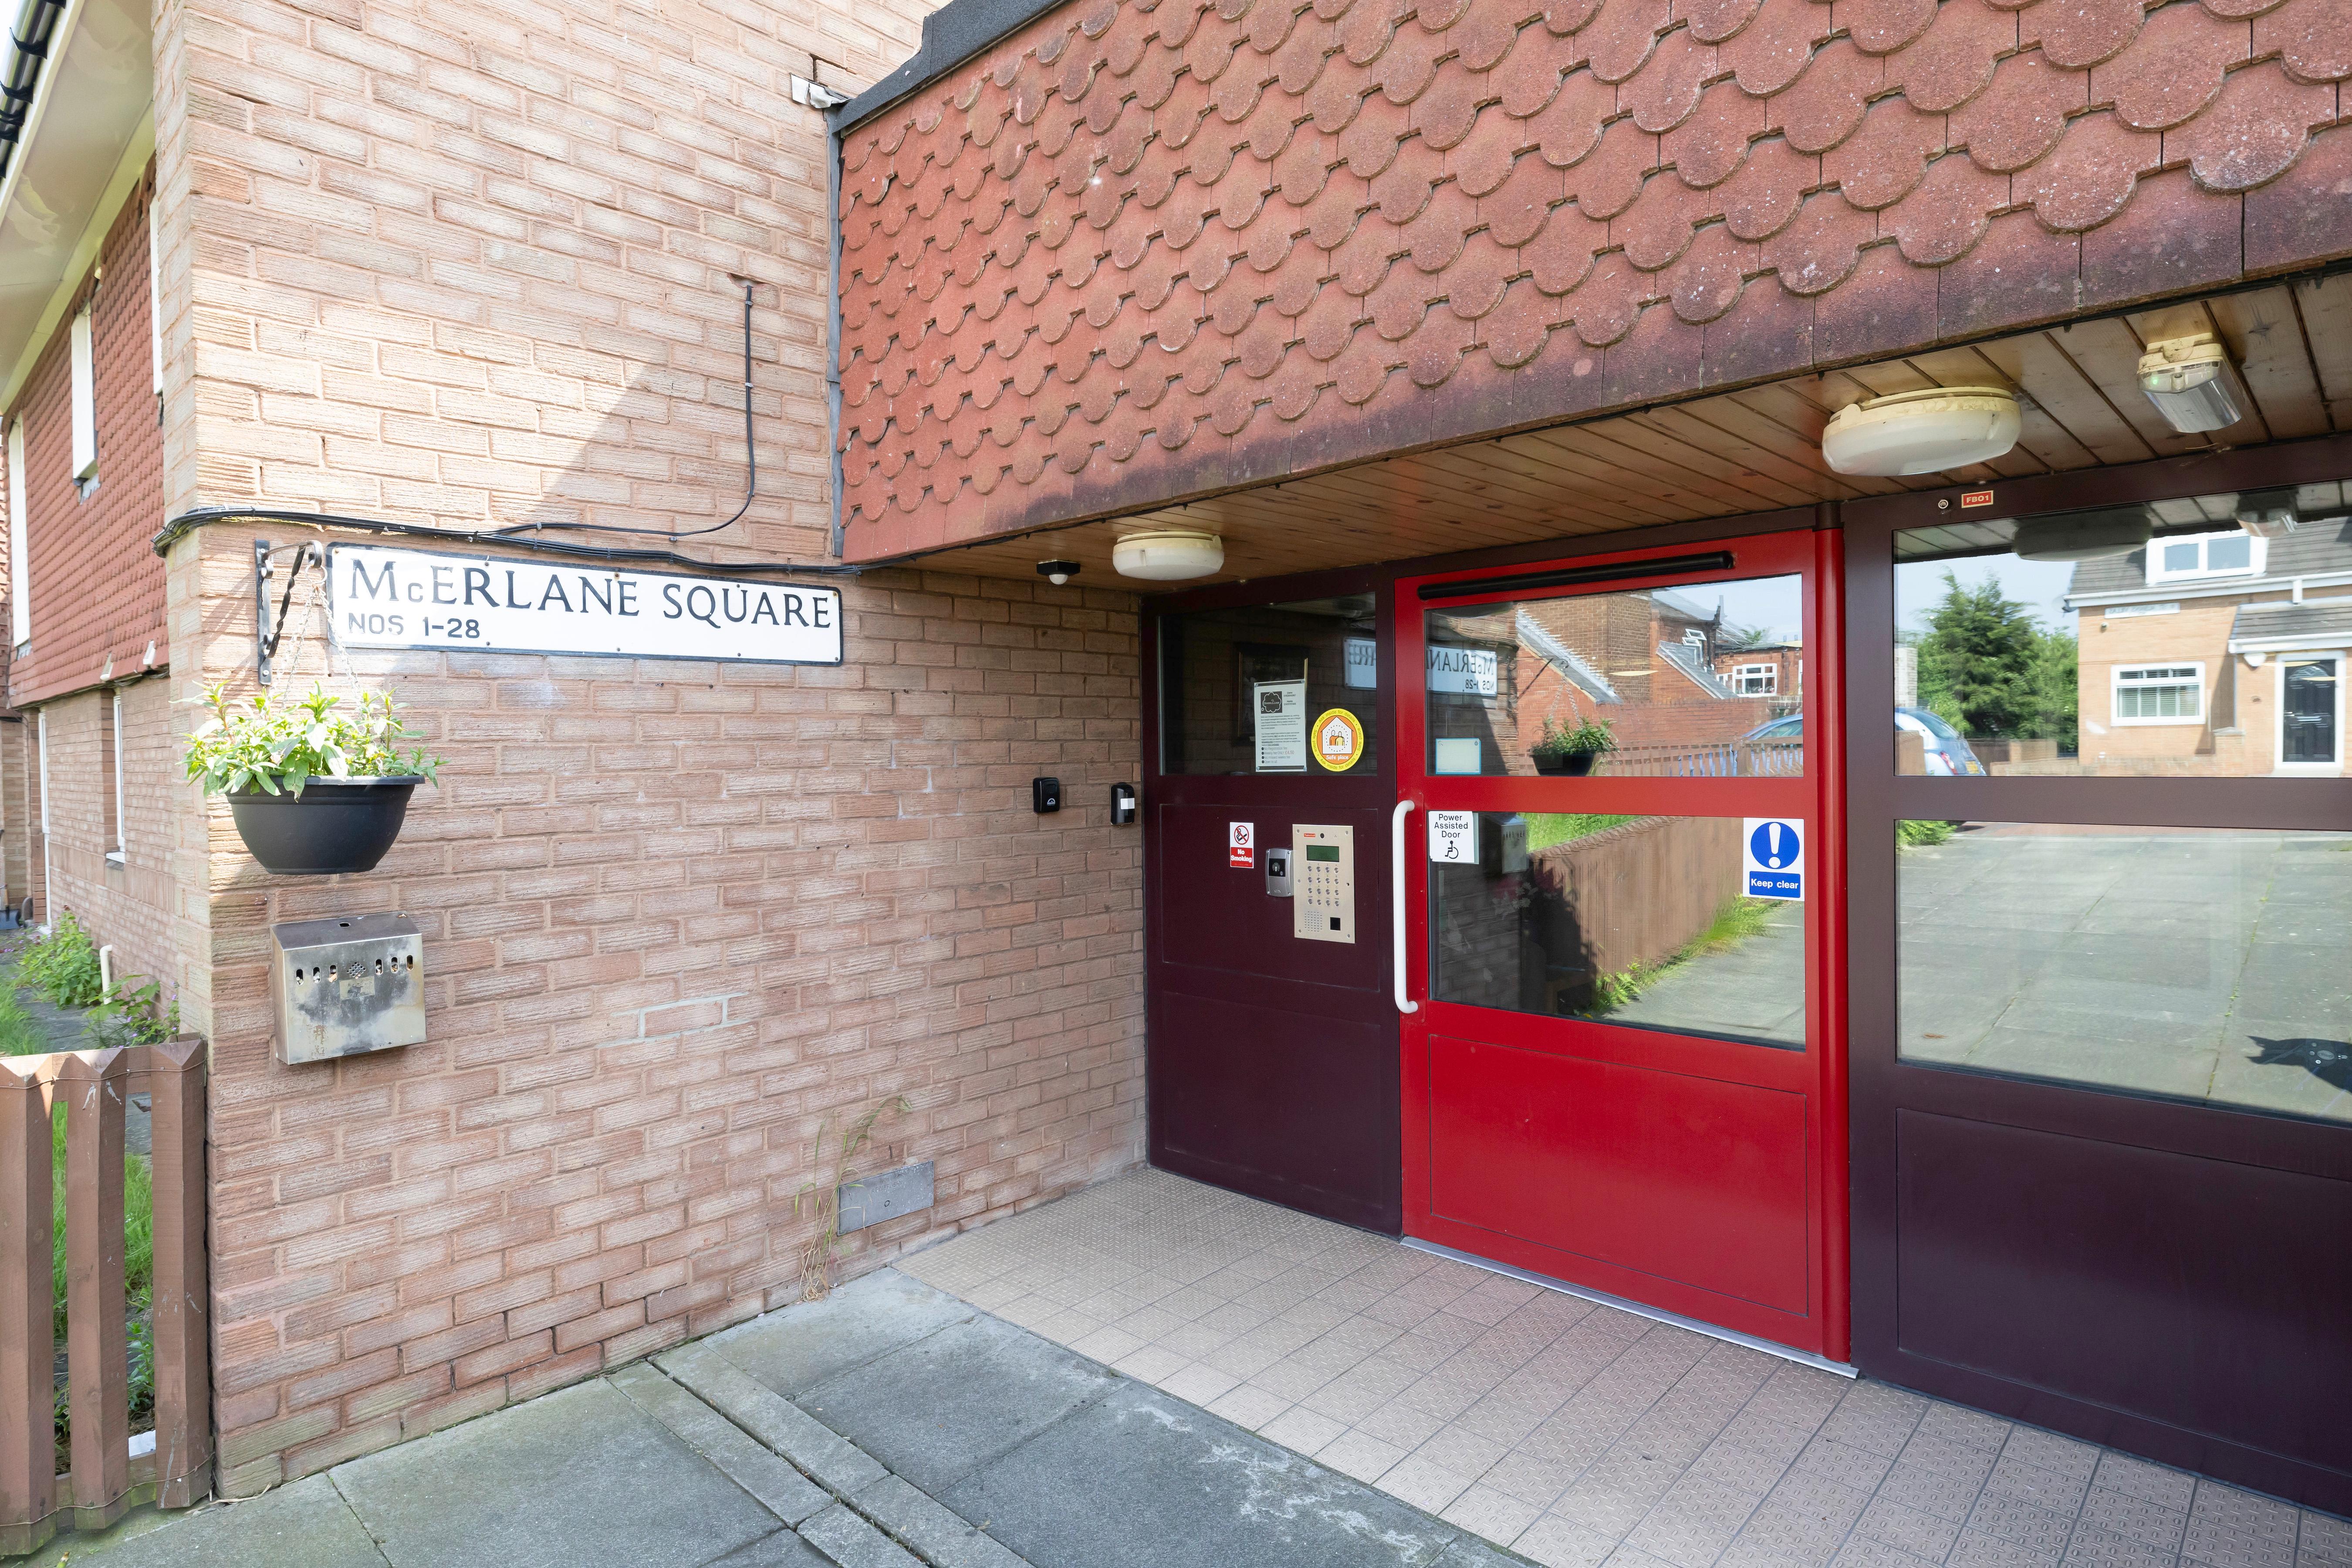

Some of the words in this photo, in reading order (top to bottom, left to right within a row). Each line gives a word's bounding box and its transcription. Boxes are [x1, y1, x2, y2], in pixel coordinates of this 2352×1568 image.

[663, 583, 831, 629] SQUARE
[348, 612, 404, 635] NOS
[422, 616, 480, 639] 1-28
[1345, 713, 1355, 722] details
[1345, 758, 1355, 767] details
[1751, 878, 1773, 889] Keep
[1777, 880, 1798, 889] clear
